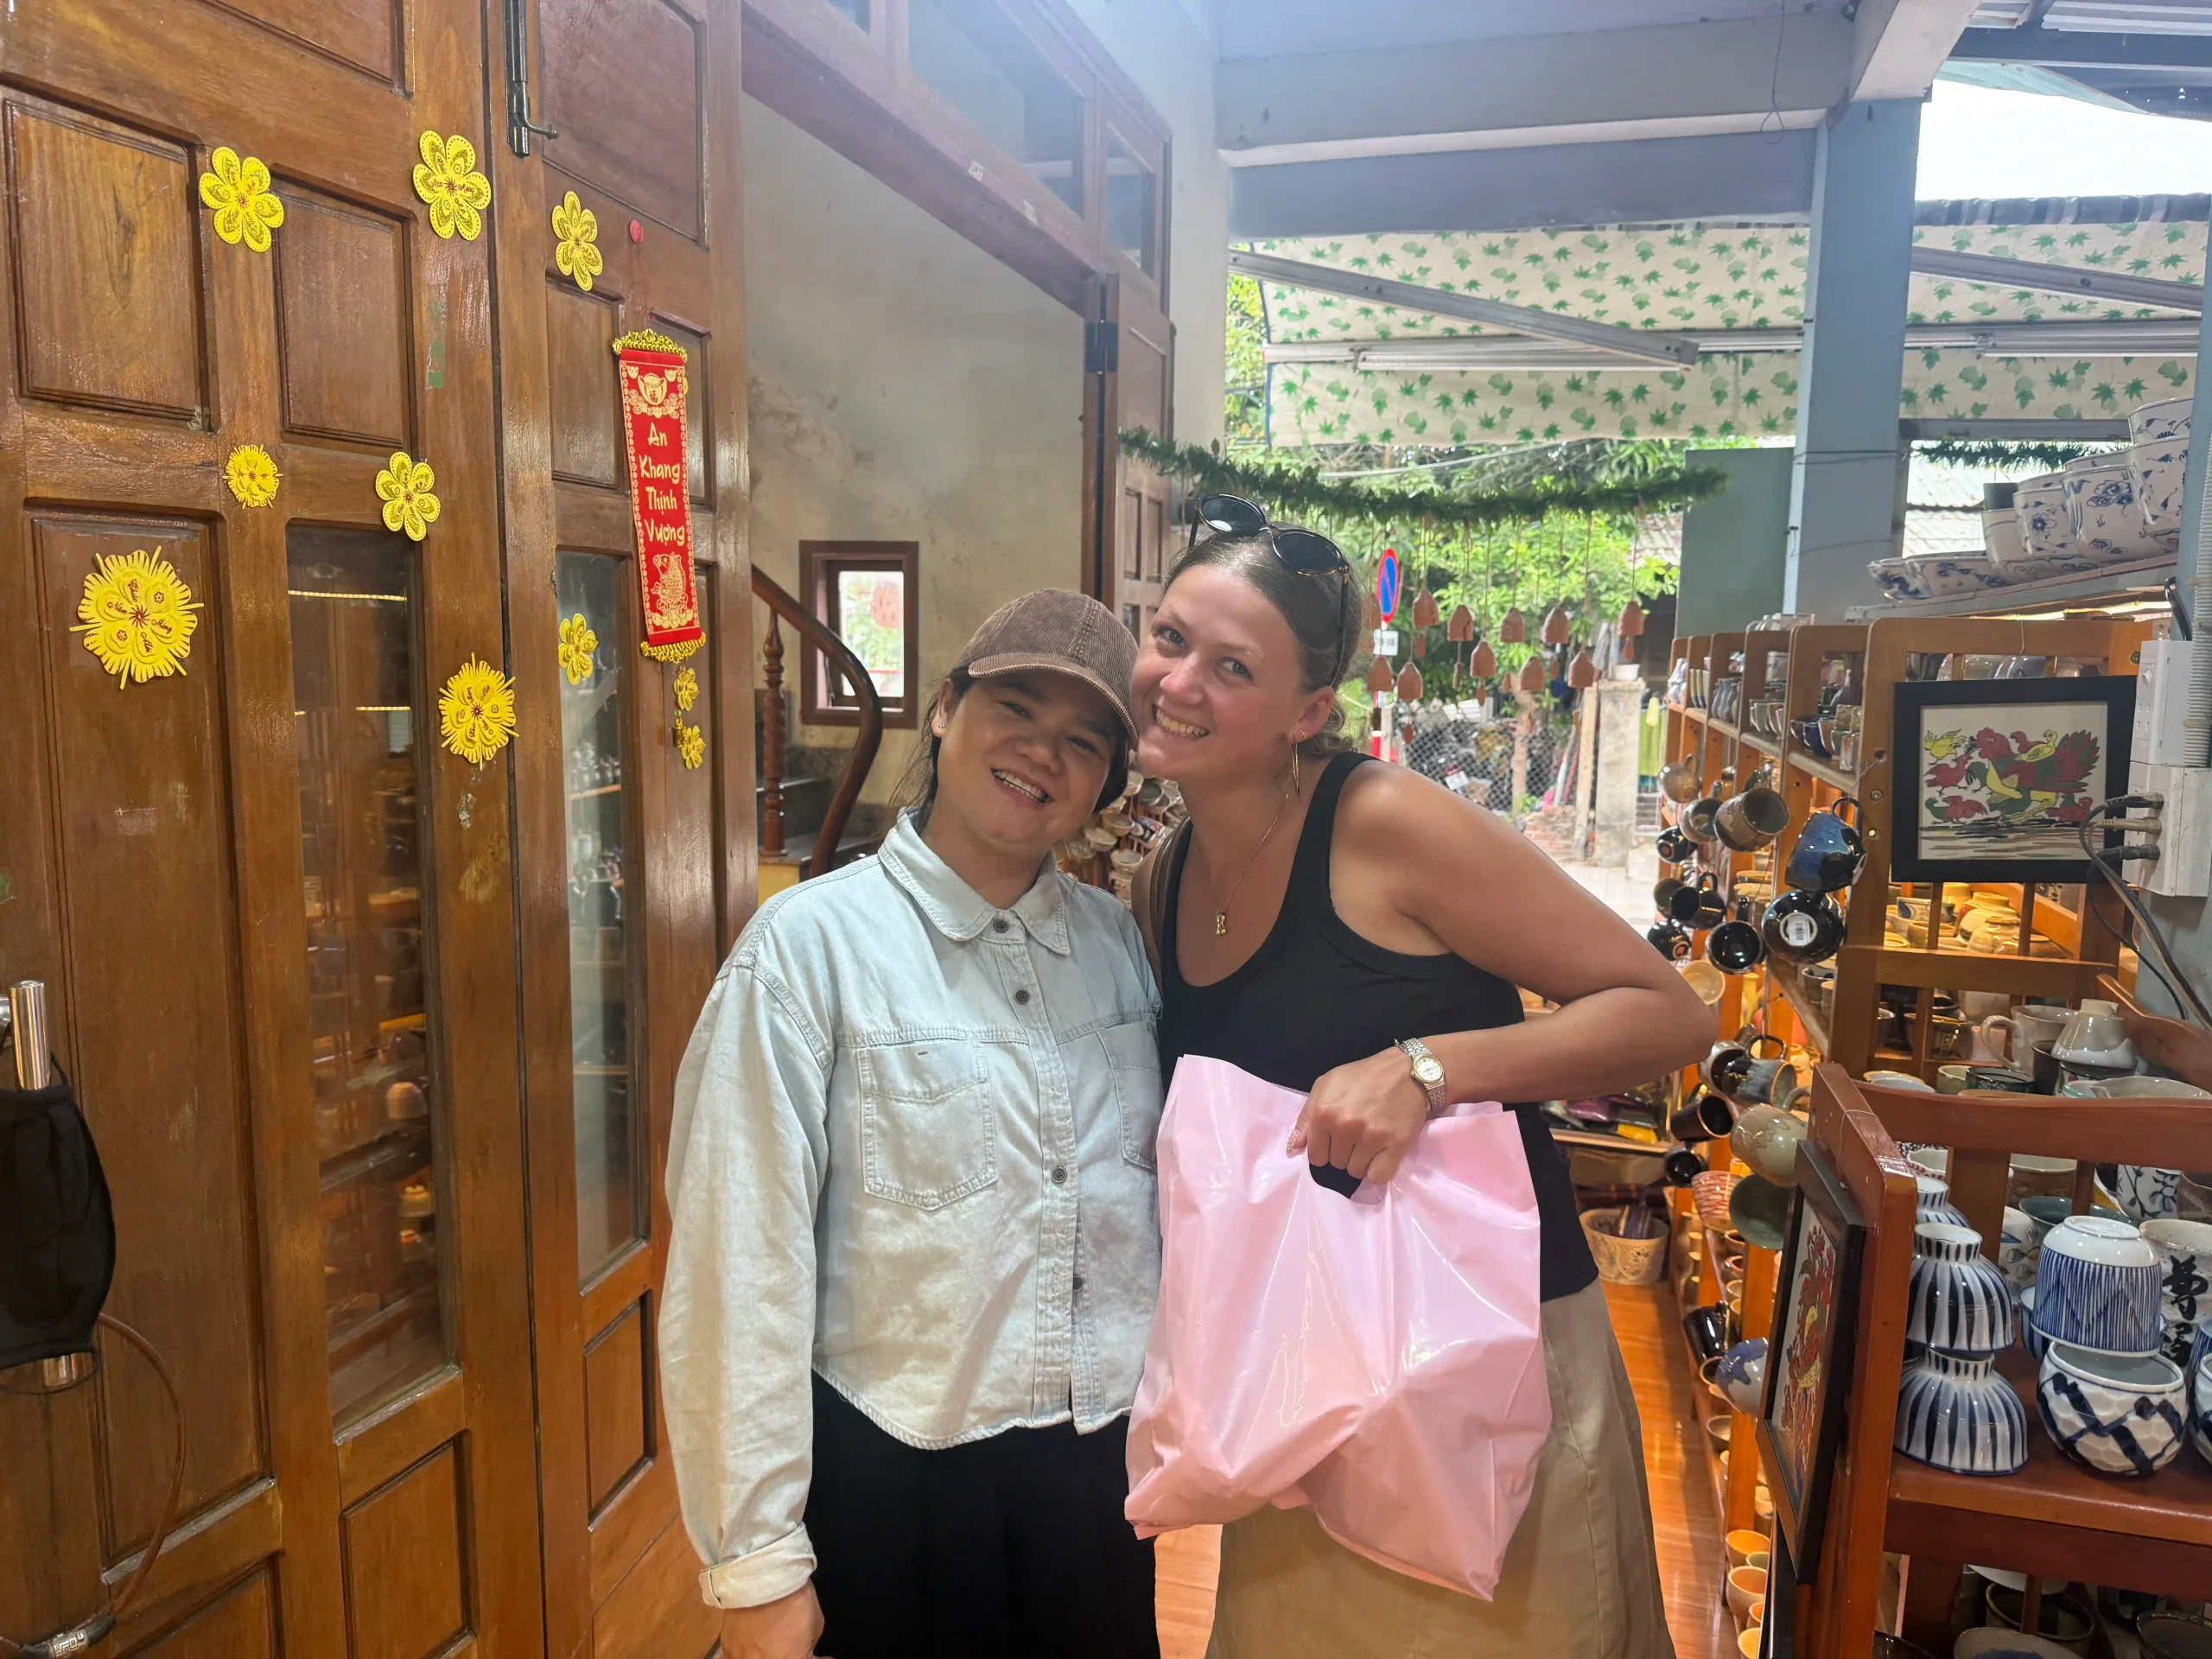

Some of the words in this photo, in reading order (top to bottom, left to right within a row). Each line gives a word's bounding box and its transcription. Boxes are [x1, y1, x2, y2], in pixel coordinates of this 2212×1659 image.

[647, 422, 668, 447] An
[639, 454, 681, 485] Khang
[645, 486, 677, 516] Thịnh
[644, 518, 685, 547] Vượng
